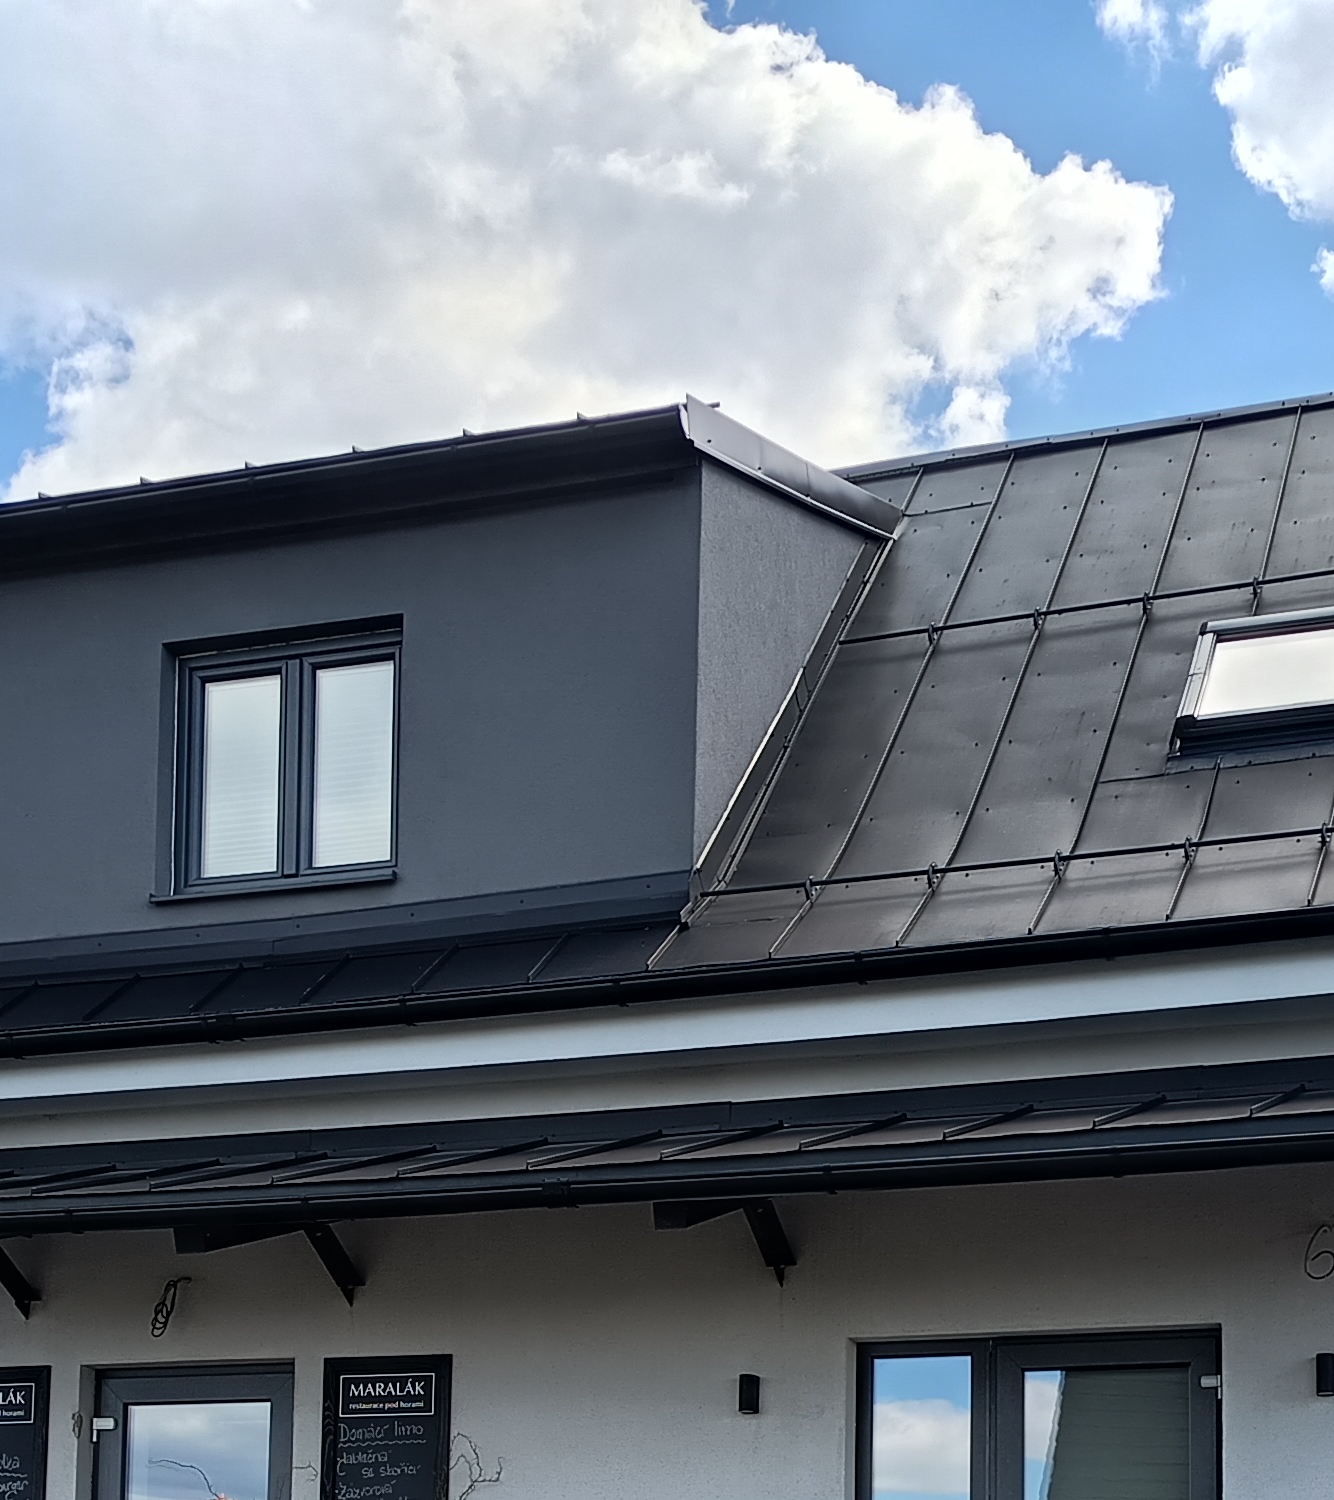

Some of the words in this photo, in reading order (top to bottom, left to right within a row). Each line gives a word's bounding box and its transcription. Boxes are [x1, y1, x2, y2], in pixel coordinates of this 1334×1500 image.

[348, 1378, 426, 1398] MARALÁK
[385, 1400, 399, 1411] pod
[394, 1420, 424, 1437] limo
